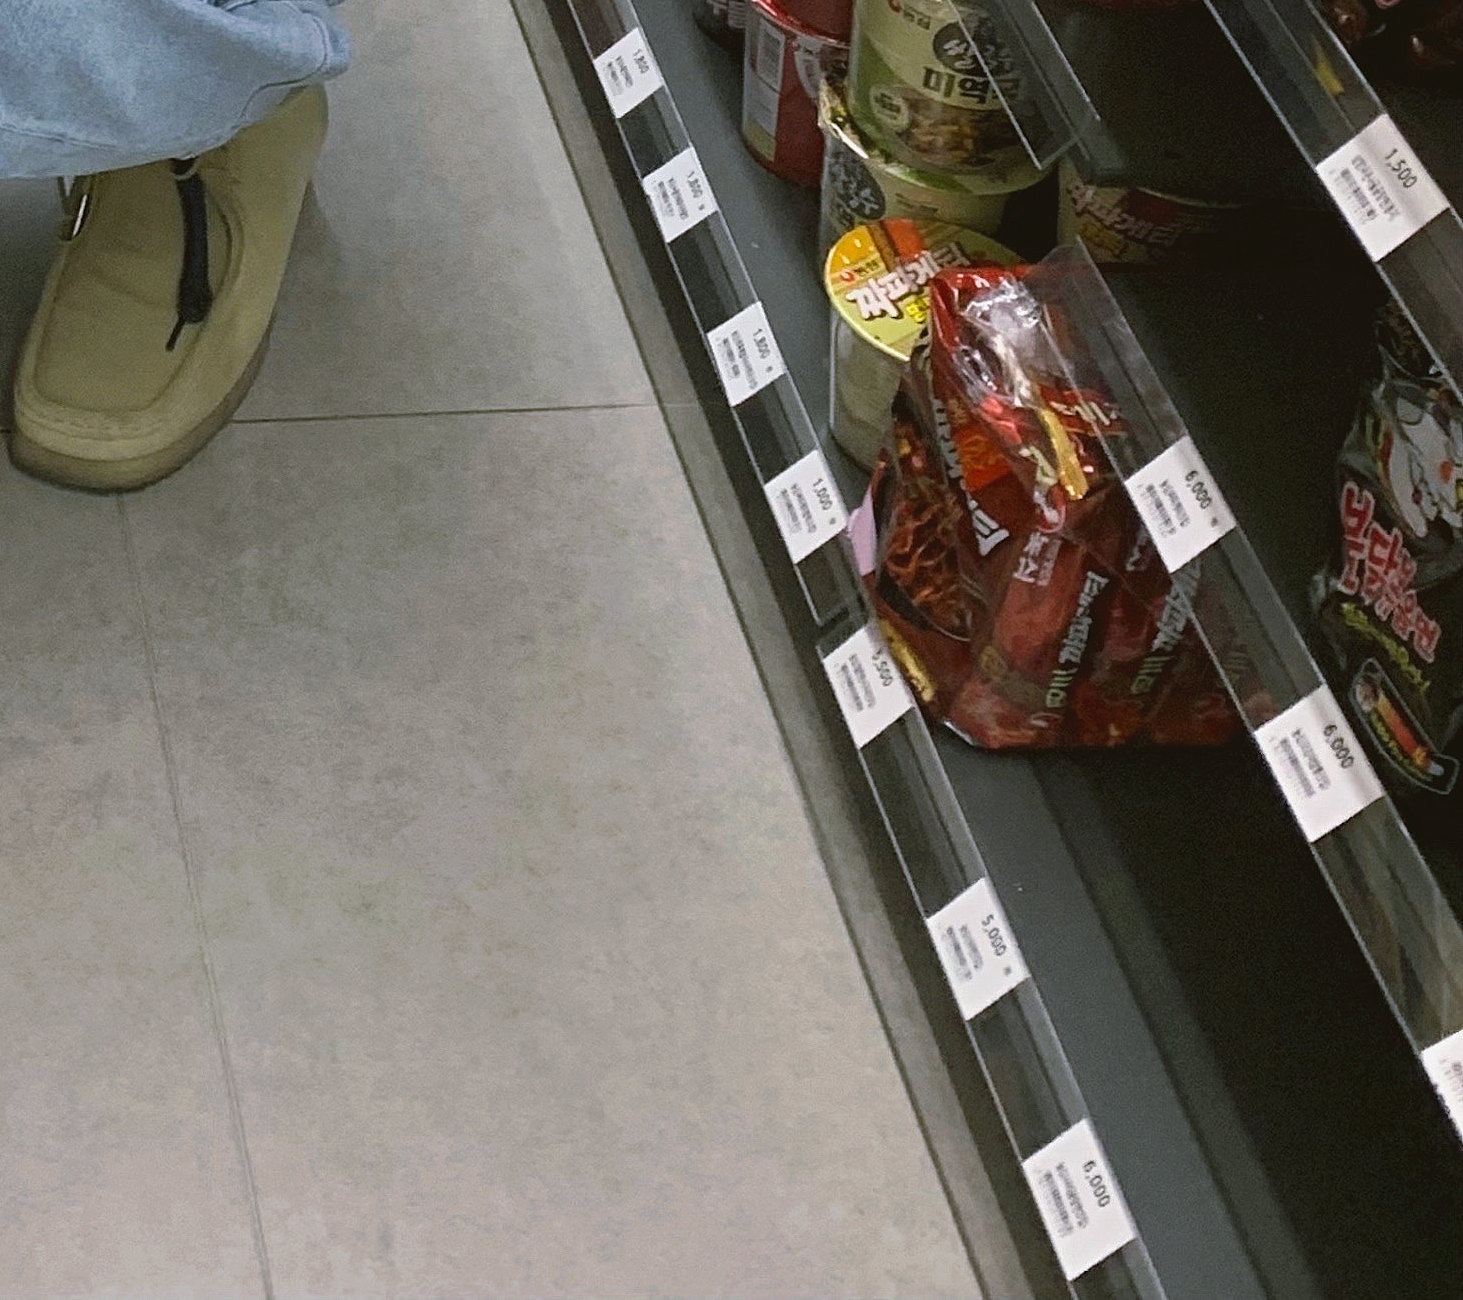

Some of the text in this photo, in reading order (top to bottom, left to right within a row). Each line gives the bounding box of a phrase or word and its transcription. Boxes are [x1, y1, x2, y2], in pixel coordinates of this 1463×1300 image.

[1383, 146, 1419, 190] 1,500
[751, 326, 775, 359] 1,800
[811, 478, 834, 513] 1,000
[1183, 468, 1213, 513] 6,000
[1322, 722, 1356, 770] 6,000
[980, 912, 1008, 958] 5,000
[1081, 1158, 1111, 1209] 6,000
